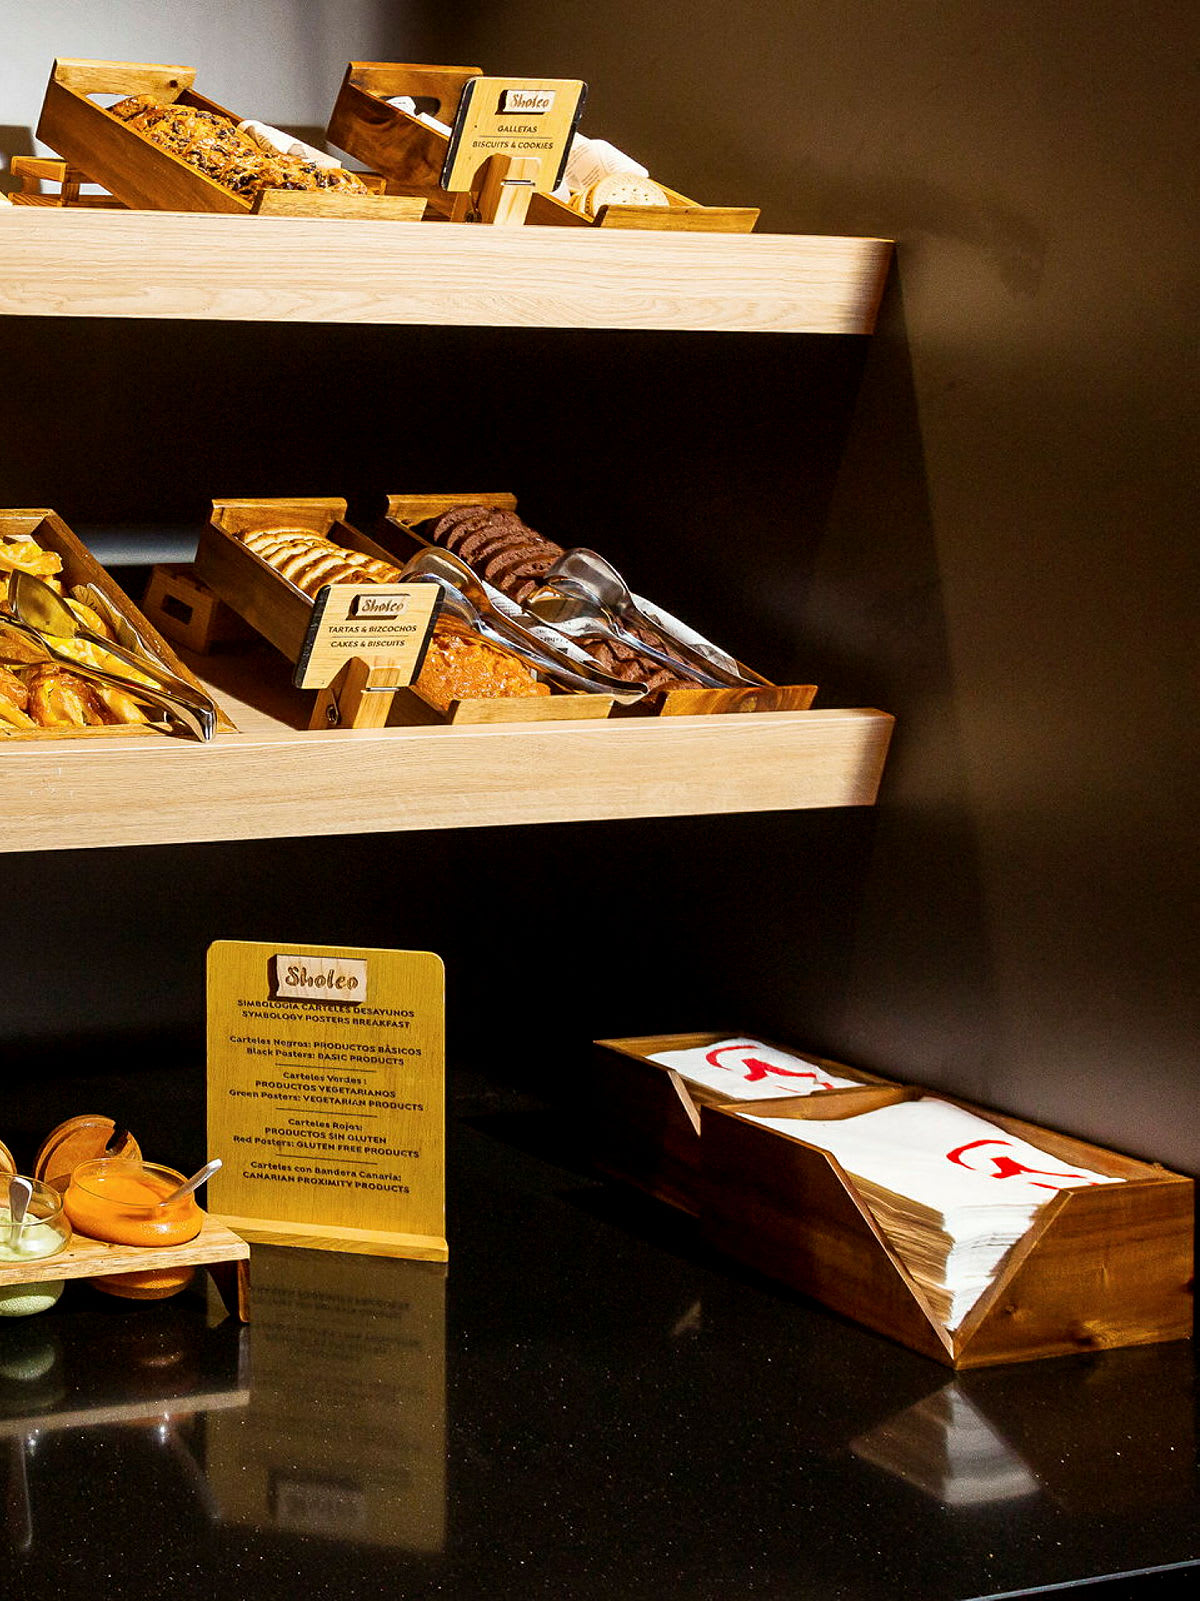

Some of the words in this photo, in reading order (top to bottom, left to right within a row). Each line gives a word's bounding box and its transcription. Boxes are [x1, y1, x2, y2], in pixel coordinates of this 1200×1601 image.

[497, 125, 537, 133] GALLETAS
[472, 141, 509, 149] BISCUITS
[518, 142, 554, 150] COOKIES
[328, 626, 359, 634] TARTAS
[369, 625, 417, 633] BIZCOCHOS
[330, 640, 358, 648] CAKES
[367, 640, 406, 648] BISCUITS
[242, 1011, 303, 1020] SYMBOLOGY
[305, 1015, 350, 1025] POSTERS
[352, 1018, 410, 1028] BREAKFAST
[301, 1004, 351, 1014] CARTELES
[353, 1007, 414, 1018] DESAYUNOS
[229, 1035, 271, 1045] Carteles
[274, 1039, 311, 1048] Negros:
[313, 1042, 376, 1053] PRODUCTOS
[246, 1047, 273, 1056] Black
[275, 1050, 315, 1059] Posters:
[318, 1053, 348, 1061] BASIC
[350, 1055, 404, 1066] PRODUCTS
[282, 1072, 325, 1081] Carteles
[255, 1080, 316, 1092] PRODUCTOS
[318, 1085, 396, 1098] VEGETARIANOS
[229, 1089, 259, 1098] Green
[261, 1091, 301, 1101] Posters:
[303, 1095, 366, 1107] VEGETARIAN
[368, 1100, 424, 1111] PRODUCTS
[288, 1118, 330, 1128] Carteles
[332, 1122, 363, 1132] Rojas:
[265, 1127, 326, 1139] PRODUCTOS
[328, 1132, 345, 1141] SIN
[347, 1134, 387, 1144] GLUTEN
[233, 1135, 252, 1143] Red
[254, 1137, 294, 1147] Posters:
[296, 1141, 335, 1150] GLUTEN
[338, 1144, 361, 1153] FREE
[364, 1147, 419, 1158] PRODUCTS
[250, 1161, 291, 1171] Carteles
[314, 1167, 356, 1177] Bandera
[359, 1171, 402, 1181] Canaria:
[243, 1171, 295, 1182] CANARIAN
[297, 1176, 352, 1188] PROXIMITY
[355, 1181, 410, 1194] PRODUCTS
